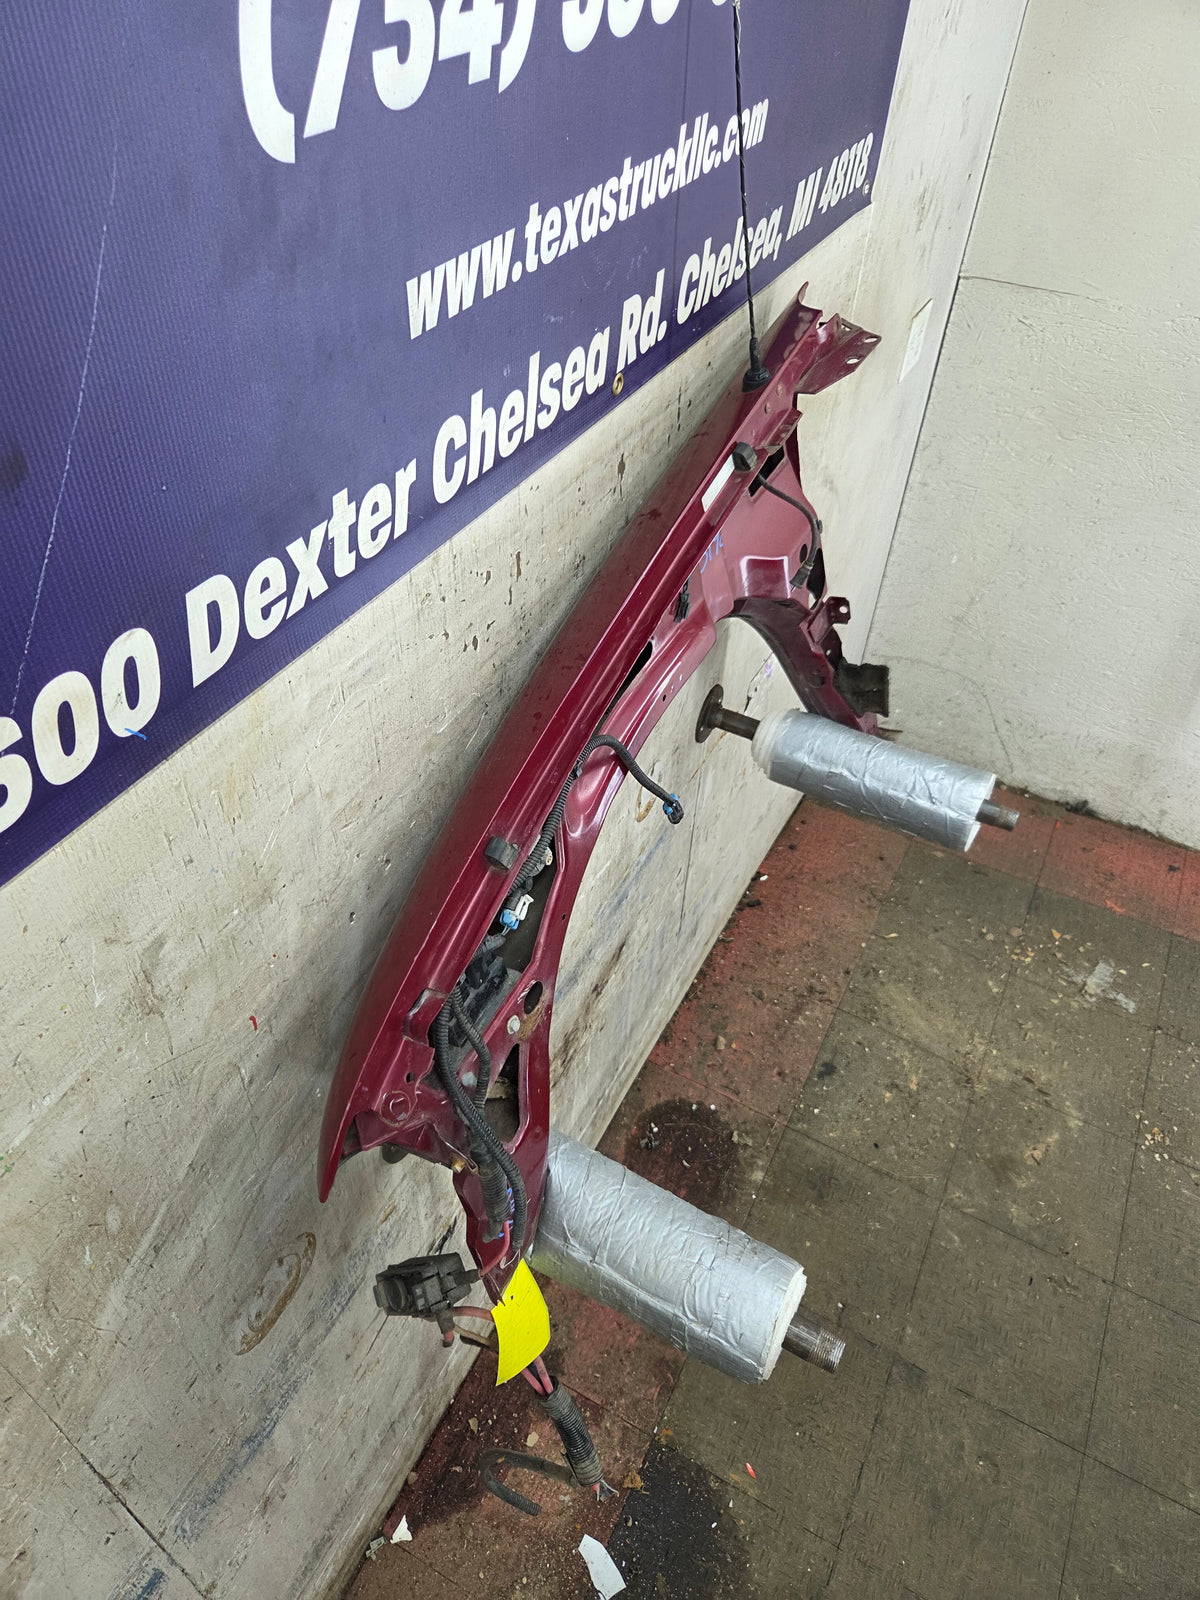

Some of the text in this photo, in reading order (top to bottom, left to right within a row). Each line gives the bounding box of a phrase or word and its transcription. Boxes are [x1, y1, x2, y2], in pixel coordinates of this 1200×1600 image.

[186, 457, 417, 688] Dexter
[433, 326, 611, 503] Chelsea
[617, 268, 668, 373] Rd.
[677, 205, 783, 324] Chelsea,
[786, 166, 824, 241] MI
[818, 132, 874, 214] 48118
[405, 98, 769, 339] www.texastruckllc.com
